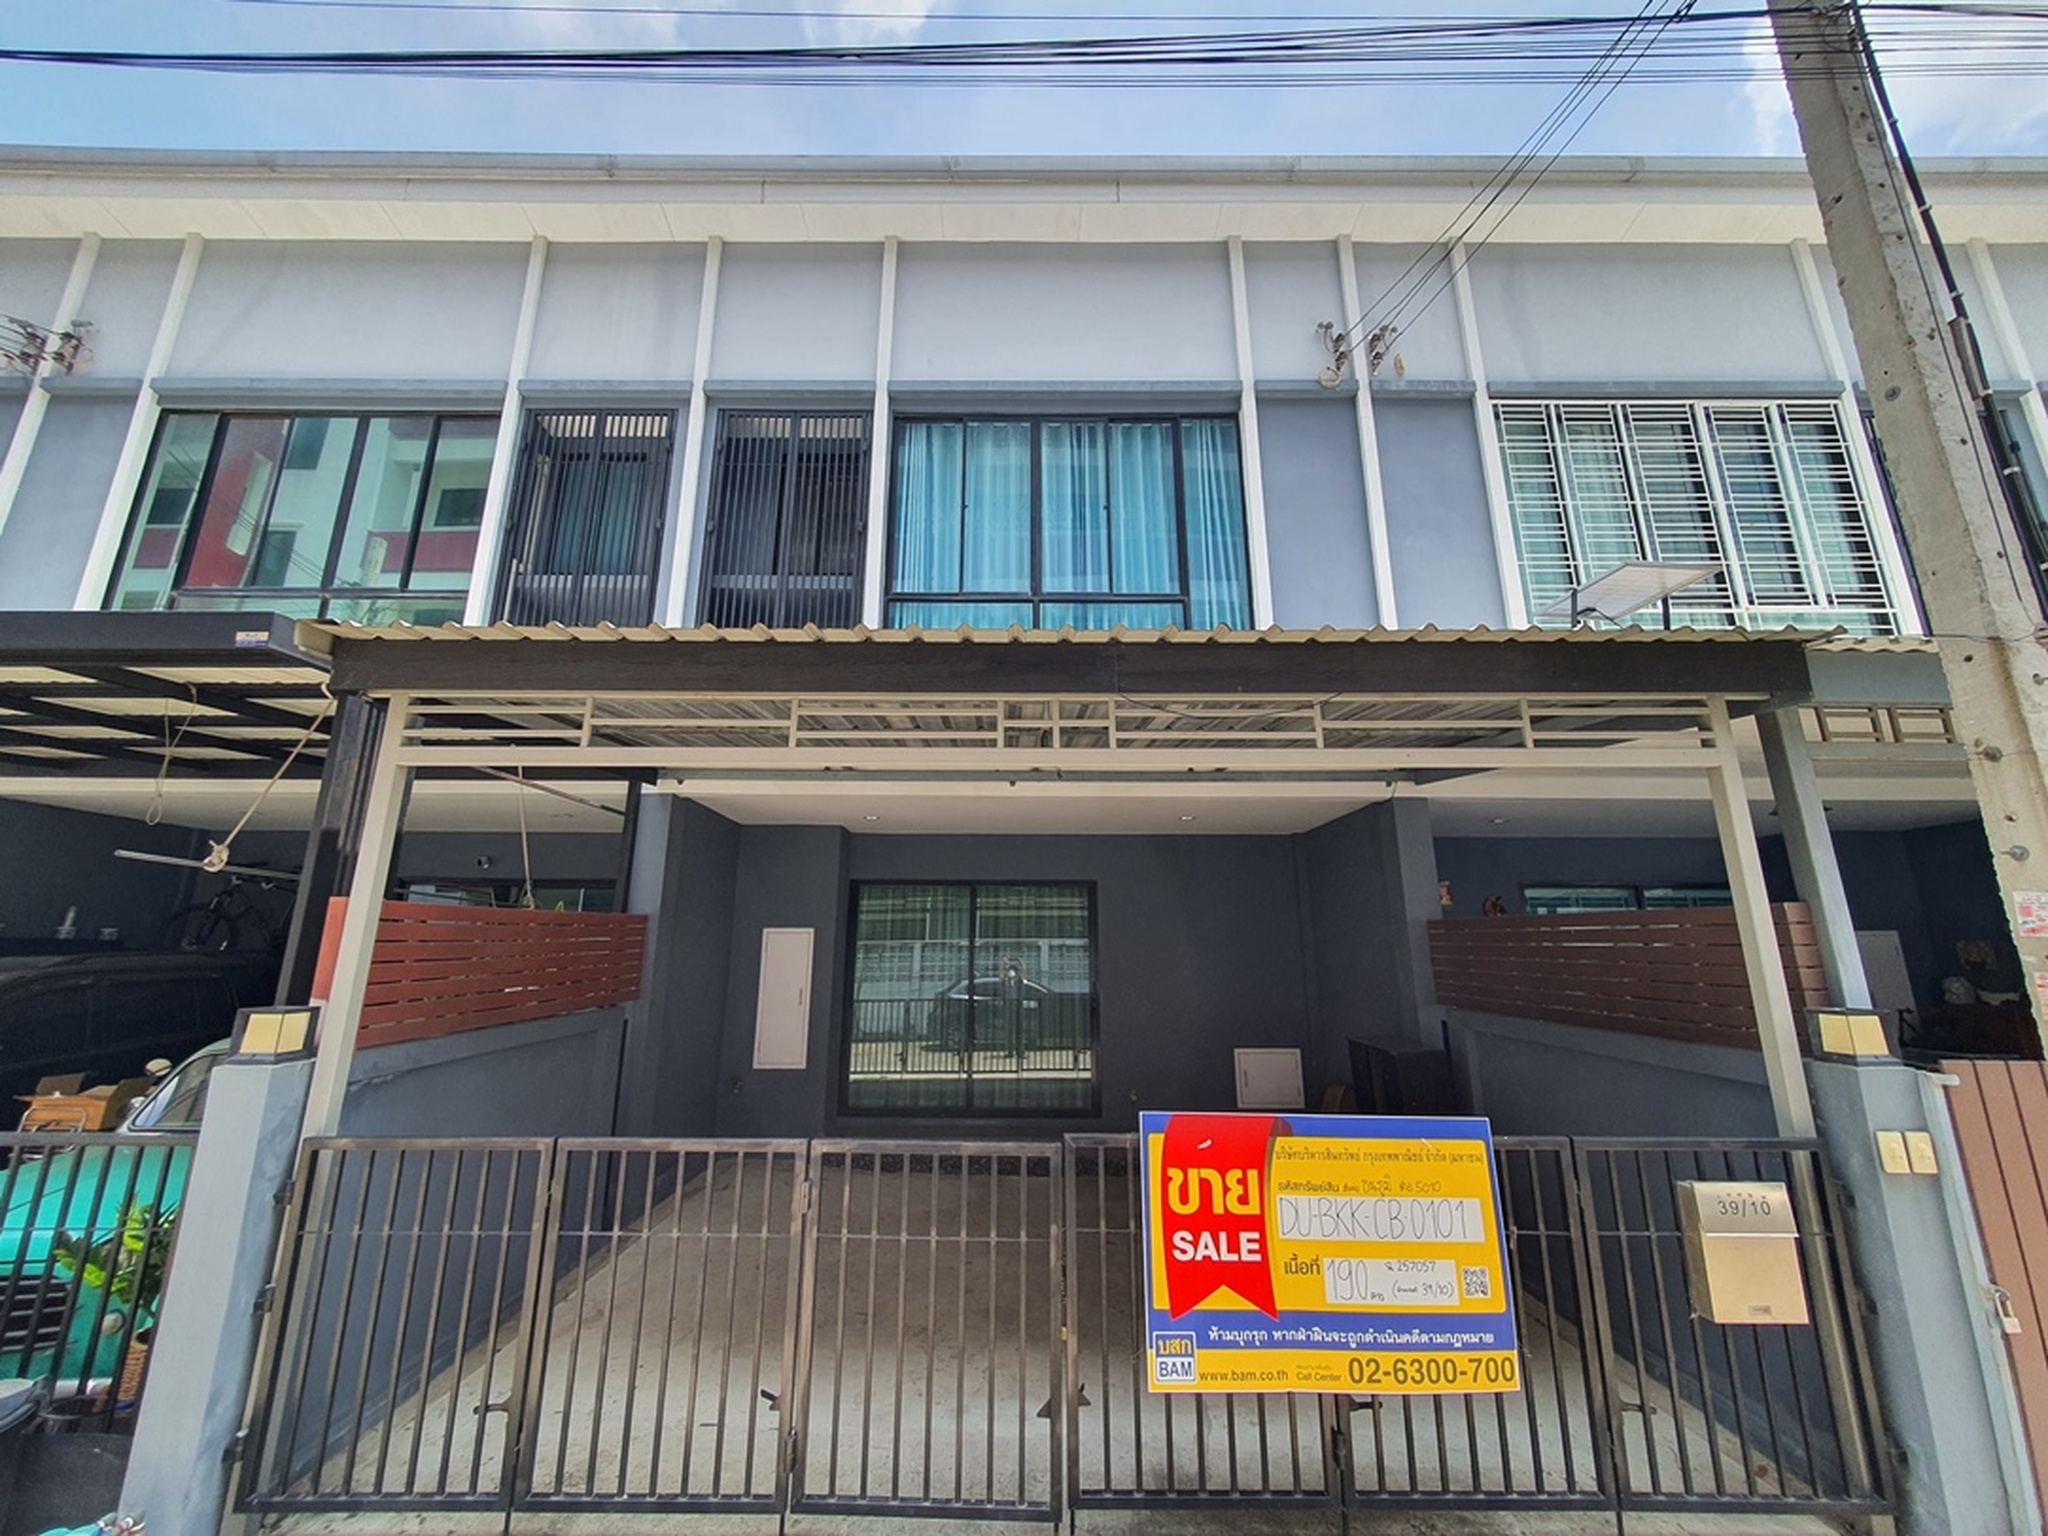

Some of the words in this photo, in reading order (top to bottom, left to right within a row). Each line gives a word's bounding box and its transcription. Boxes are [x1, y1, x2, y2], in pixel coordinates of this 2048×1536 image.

[1167, 1167, 1261, 1215] ขาย
[1717, 1199, 1771, 1217] 39/10
[1172, 1230, 1262, 1262] SALE
[1284, 1254, 1321, 1276] เนื้อที่
[1208, 1326, 1268, 1346] ห้ามบุกรุก
[1157, 1338, 1192, 1355] บสก
[1158, 1360, 1193, 1378] BAM
[1199, 1369, 1289, 1382] www.bam.co.th
[1296, 1371, 1312, 1382] Call
[1313, 1371, 1342, 1382] Center
[1349, 1356, 1516, 1384] 02-6300-700
